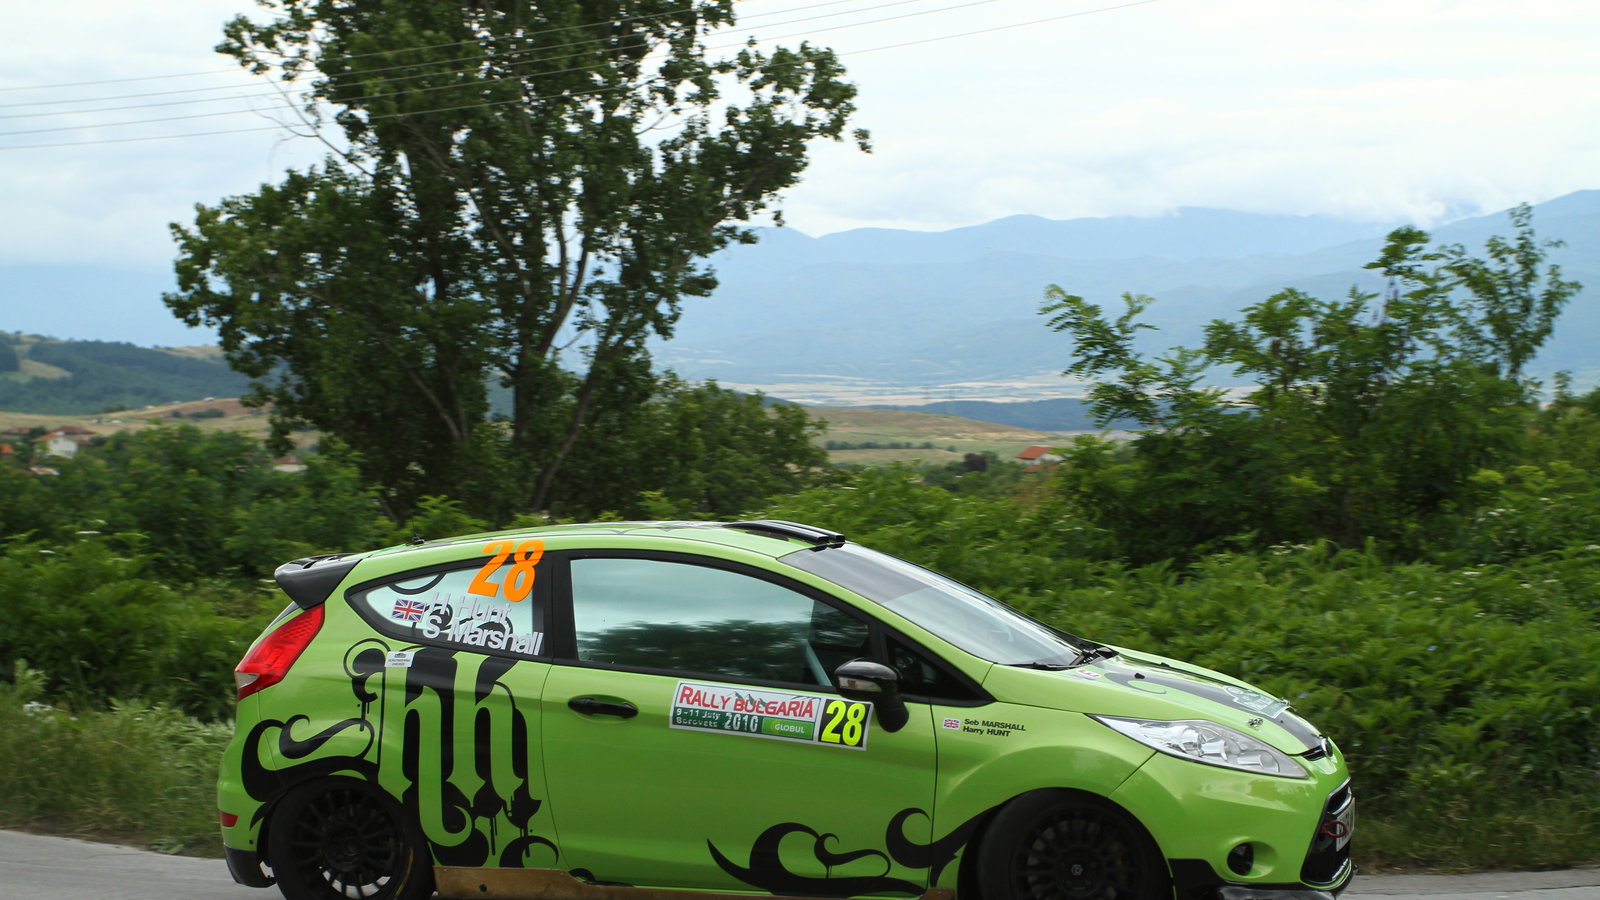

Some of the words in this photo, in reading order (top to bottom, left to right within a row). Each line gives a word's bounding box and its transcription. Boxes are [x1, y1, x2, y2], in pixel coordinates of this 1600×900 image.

[467, 539, 544, 602] 28
[425, 591, 452, 615] H
[455, 595, 512, 626] Hunt
[422, 615, 442, 639] S
[447, 620, 544, 656] Marshall
[679, 685, 732, 710] RALLY
[733, 697, 814, 718] BULGARIA
[702, 711, 721, 721] July
[724, 712, 759, 733] 2010
[775, 723, 804, 734] GLOBUL
[821, 700, 866, 746] 28
[964, 718, 979, 726] Seb
[981, 720, 1026, 732] MARSHALL
[963, 726, 984, 735] Harry
[986, 729, 1011, 737] HUNT
